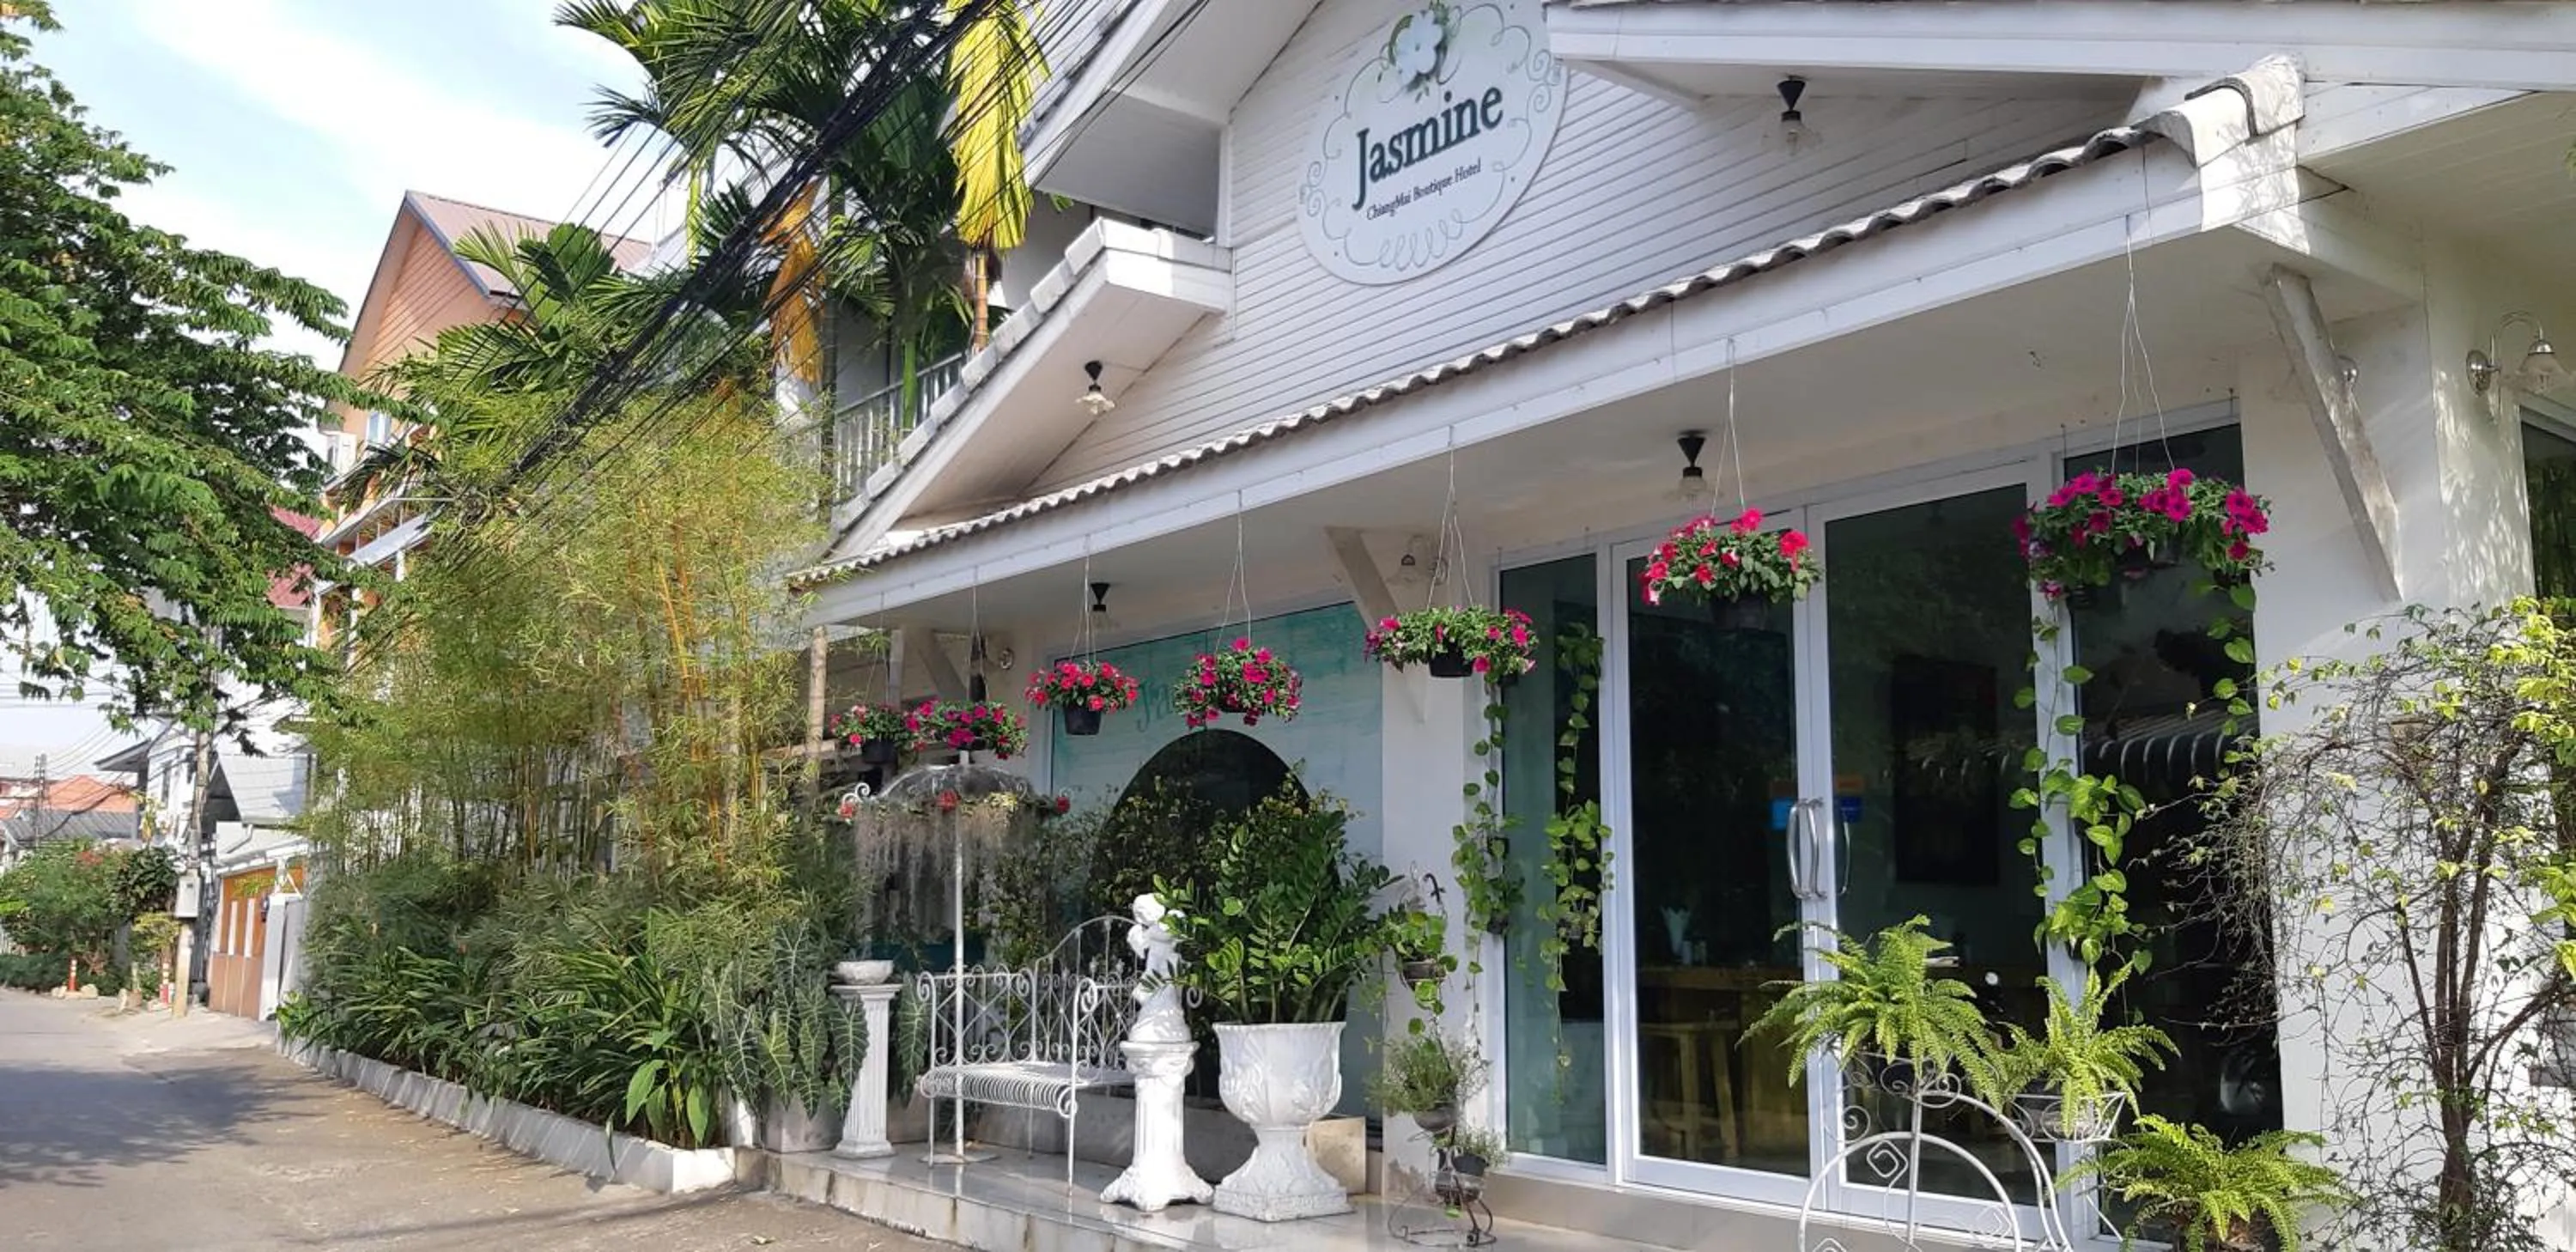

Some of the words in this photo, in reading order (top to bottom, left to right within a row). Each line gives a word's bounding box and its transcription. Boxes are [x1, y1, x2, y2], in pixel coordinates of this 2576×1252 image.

[1352, 87, 1504, 211] Jasmine
[1413, 176, 1453, 201] Boutique
[1455, 156, 1481, 183] Hotel
